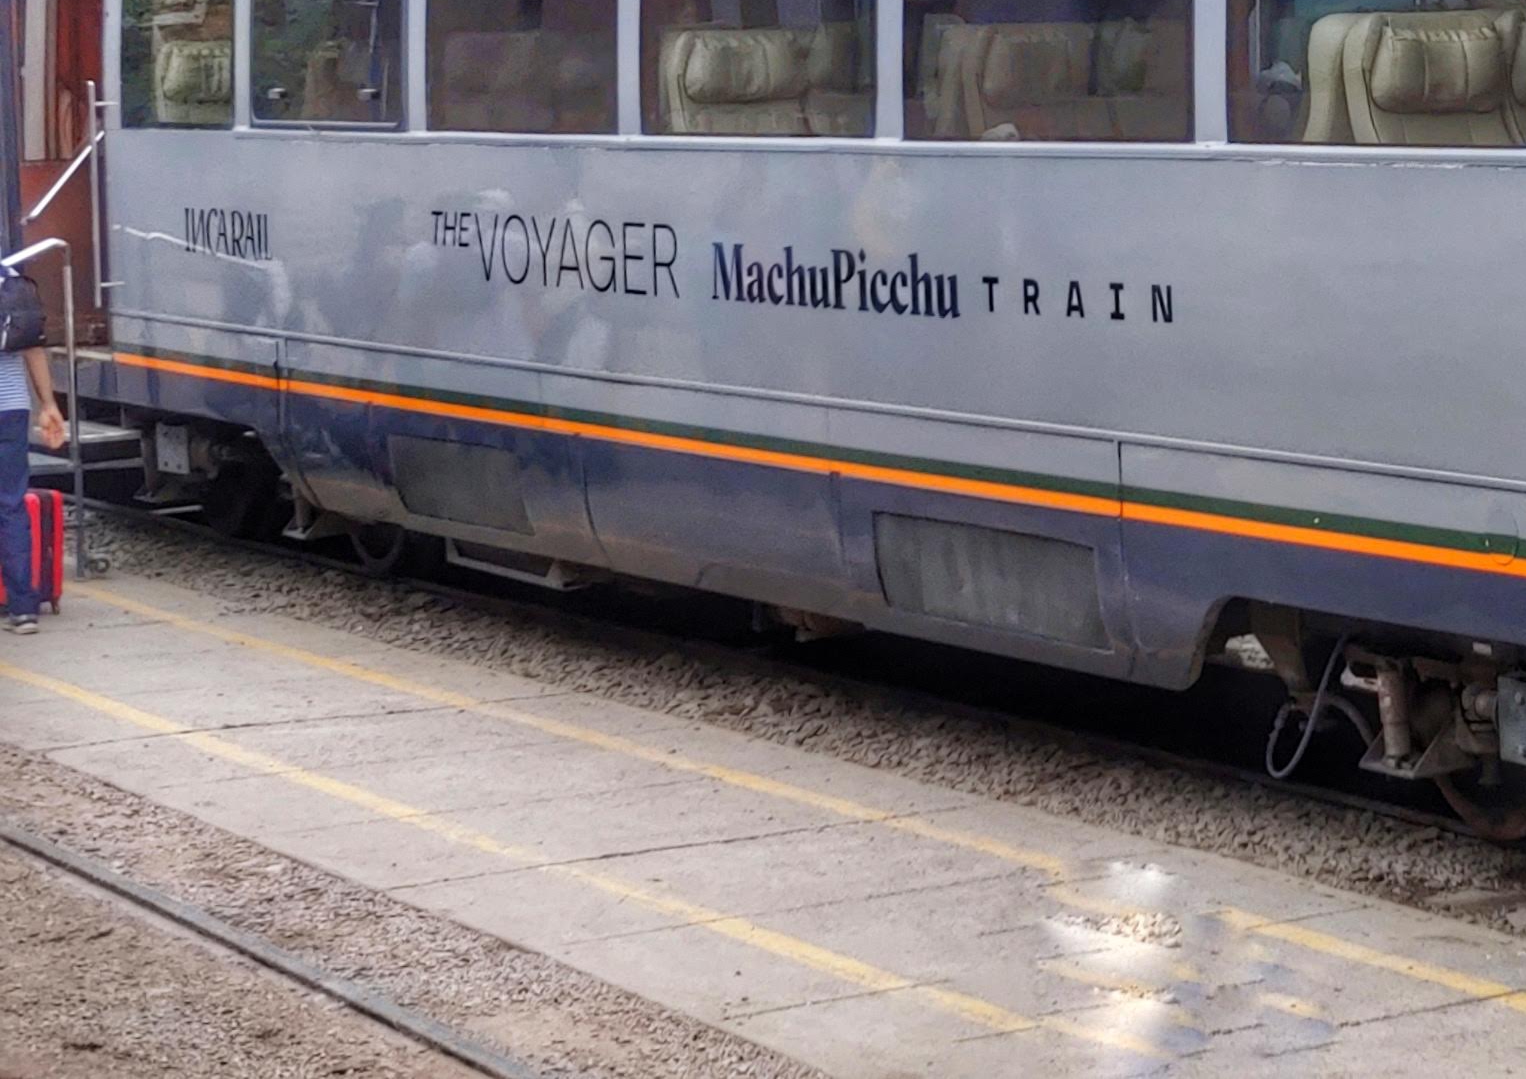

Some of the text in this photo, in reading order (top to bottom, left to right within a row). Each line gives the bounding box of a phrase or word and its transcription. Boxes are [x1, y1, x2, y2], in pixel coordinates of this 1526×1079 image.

[431, 210, 679, 298] THE VOYAGER
[712, 241, 1174, 323] MachuPicchu TRAIN
